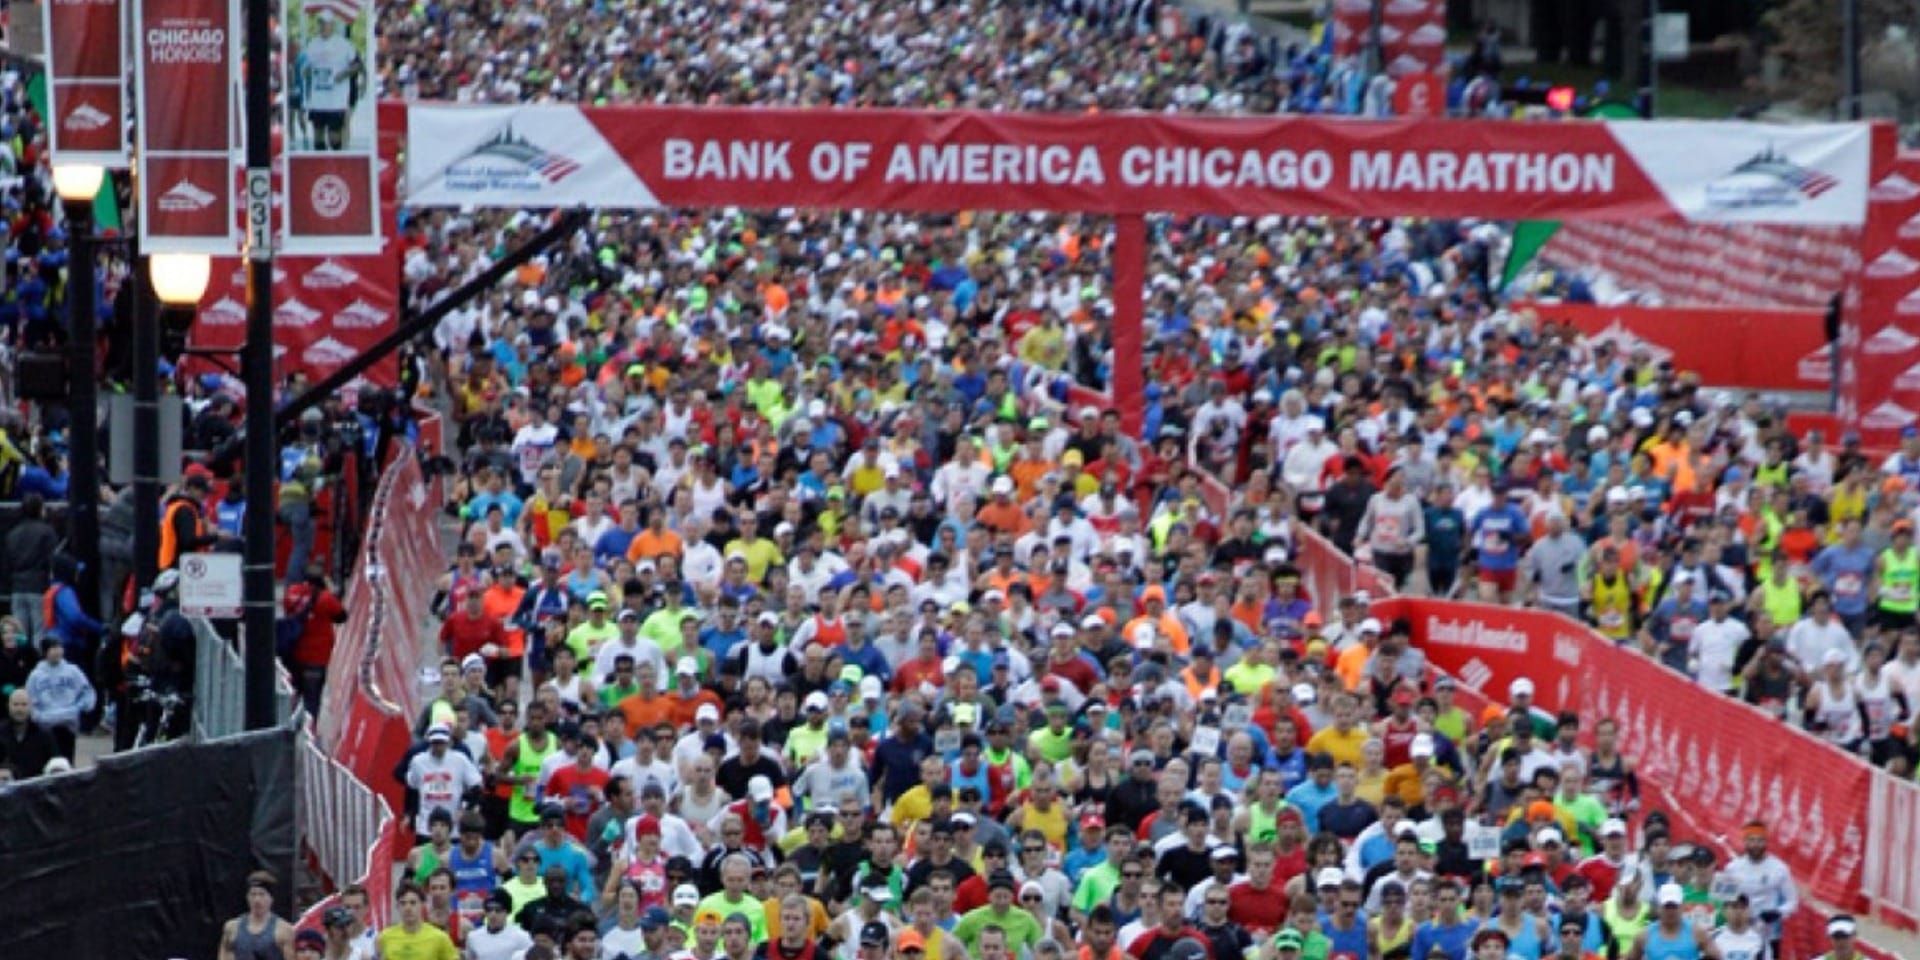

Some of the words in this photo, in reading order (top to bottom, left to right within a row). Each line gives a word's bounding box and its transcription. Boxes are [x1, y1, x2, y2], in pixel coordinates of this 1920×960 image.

[148, 28, 224, 45] CHICAGO
[151, 45, 222, 63] HONORS
[662, 138, 794, 181] BANK
[808, 142, 872, 183] OF
[884, 142, 1106, 185] AMERICA
[1119, 144, 1334, 189] CHICAGO
[1350, 148, 1616, 194] MARATHON
[250, 174, 269, 248] C31
